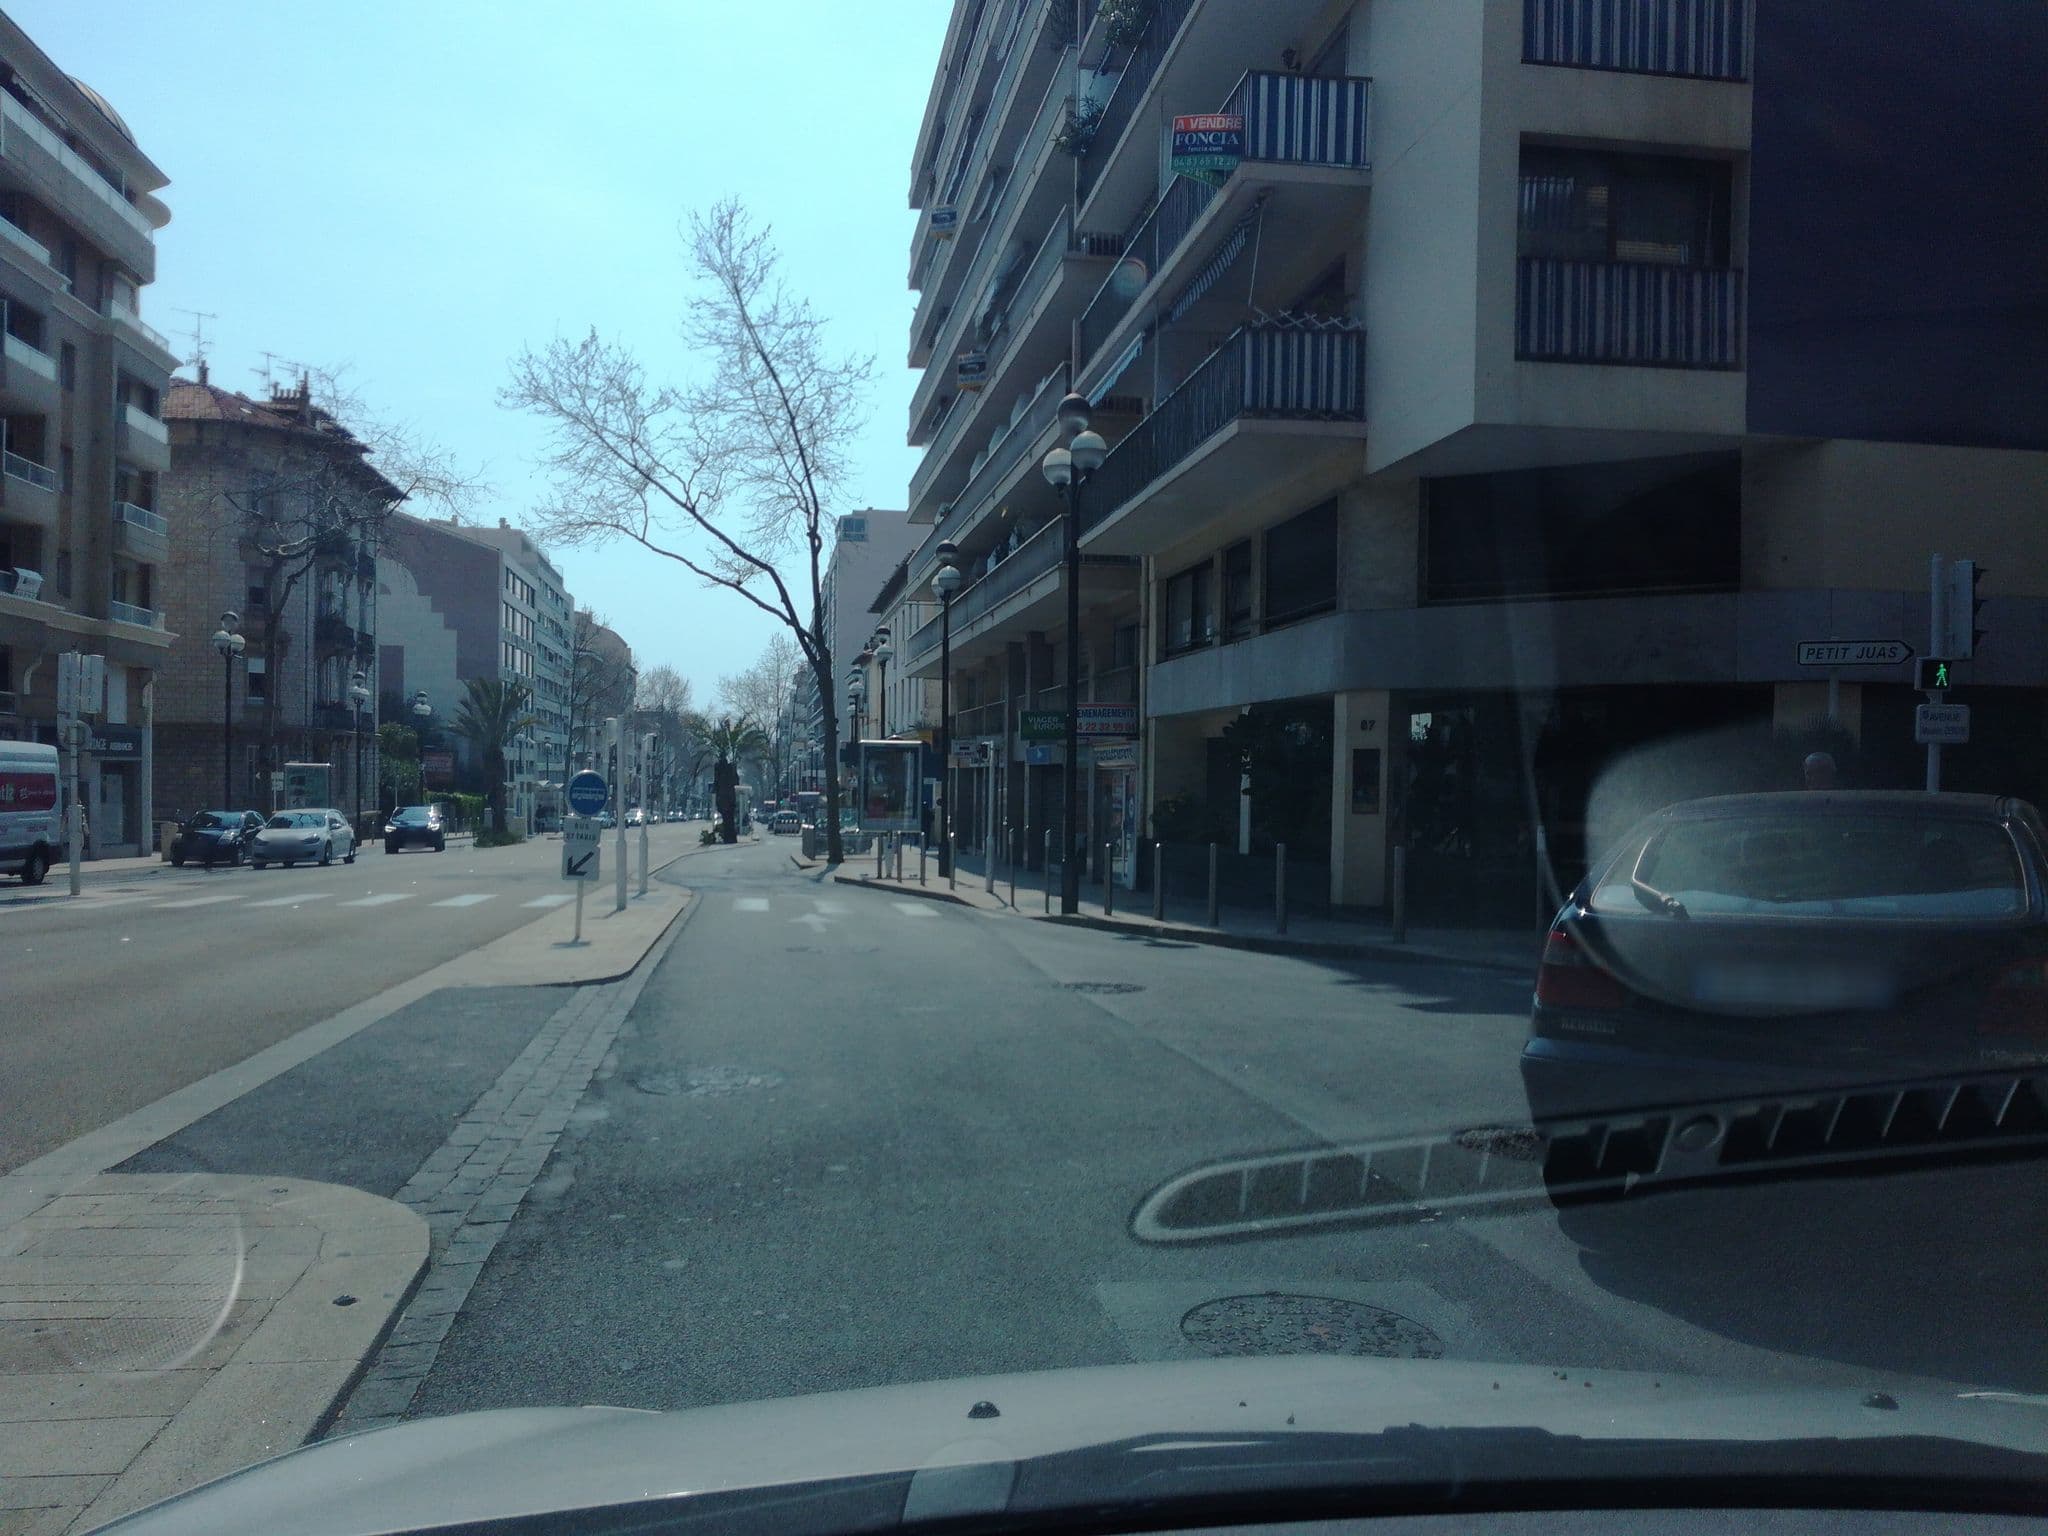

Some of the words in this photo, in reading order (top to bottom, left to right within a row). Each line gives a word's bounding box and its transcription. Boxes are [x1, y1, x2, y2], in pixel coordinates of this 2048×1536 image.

[1176, 119, 1185, 130] A
[1190, 117, 1242, 129] VENDRE
[1175, 132, 1239, 146] FONCIA
[1805, 647, 1851, 660] PETIT
[1856, 646, 1898, 659] JUAS
[1077, 708, 1135, 718] EMENAGEMENTS
